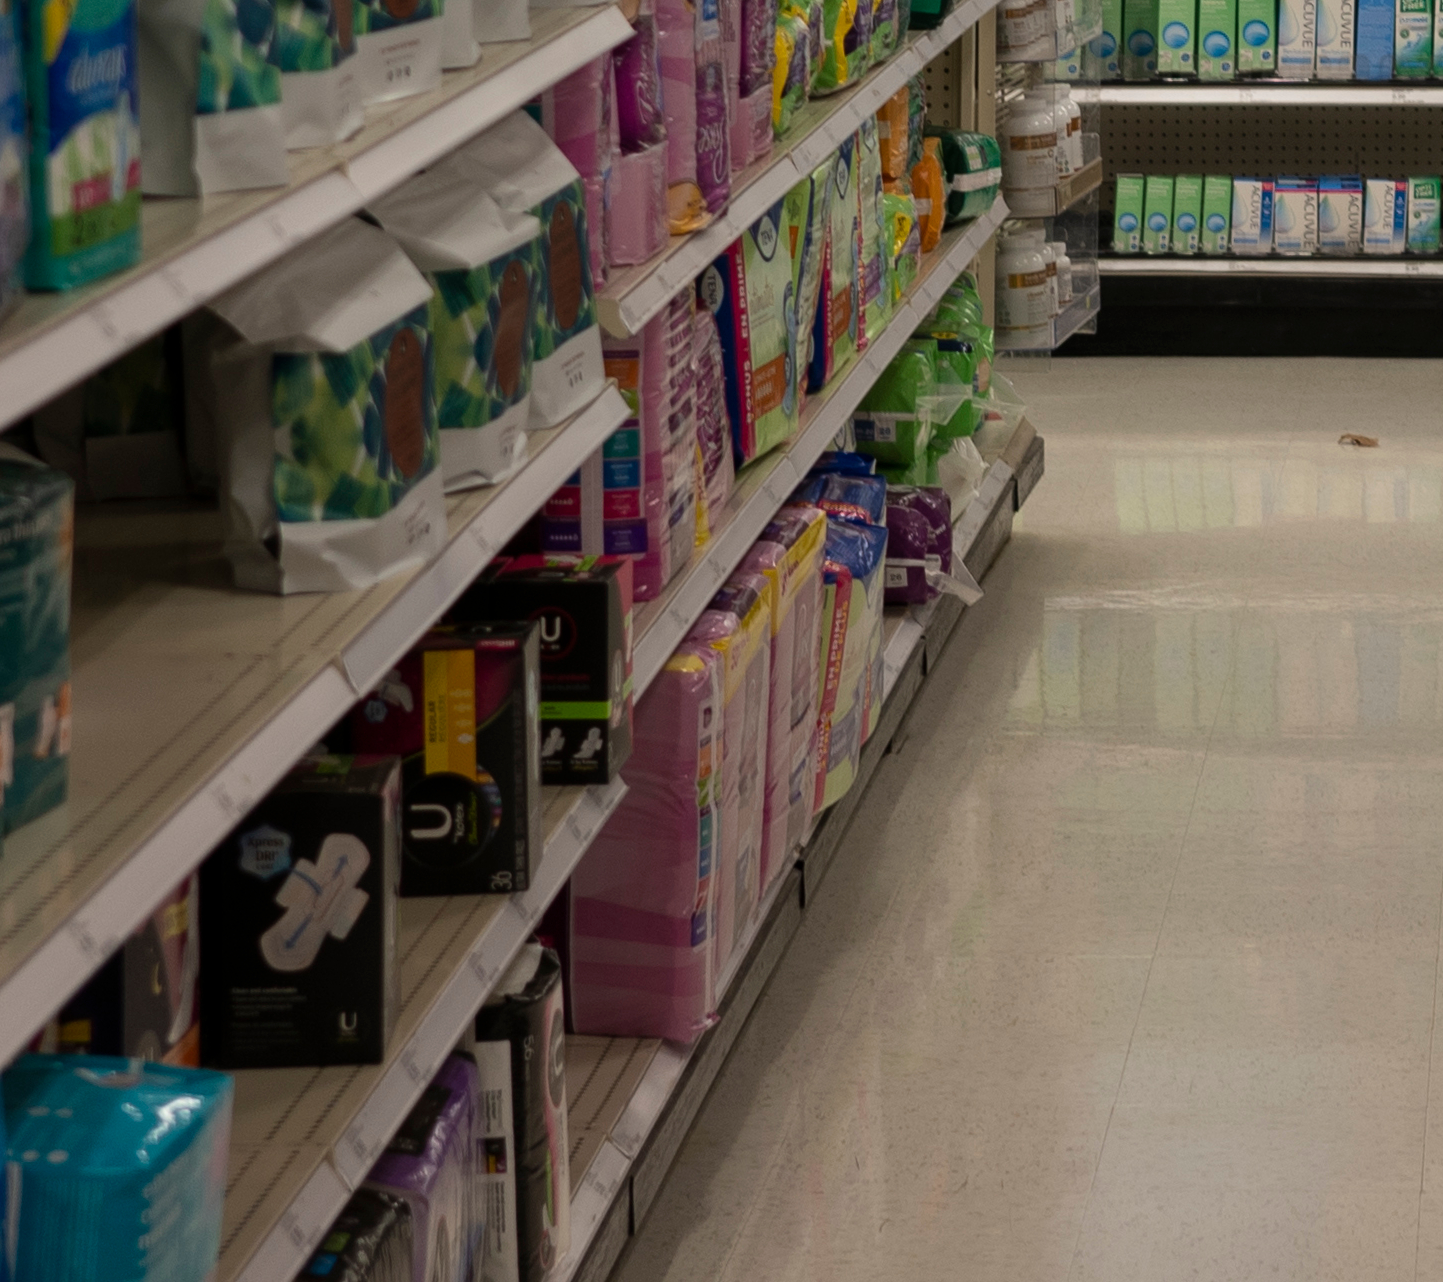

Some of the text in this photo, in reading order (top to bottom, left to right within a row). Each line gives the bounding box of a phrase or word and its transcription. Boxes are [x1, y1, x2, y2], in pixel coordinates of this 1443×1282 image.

[707, 272, 718, 307] TENA
[735, 252, 753, 425] BONUS EN PRIME
[427, 700, 437, 744] REGULAR
